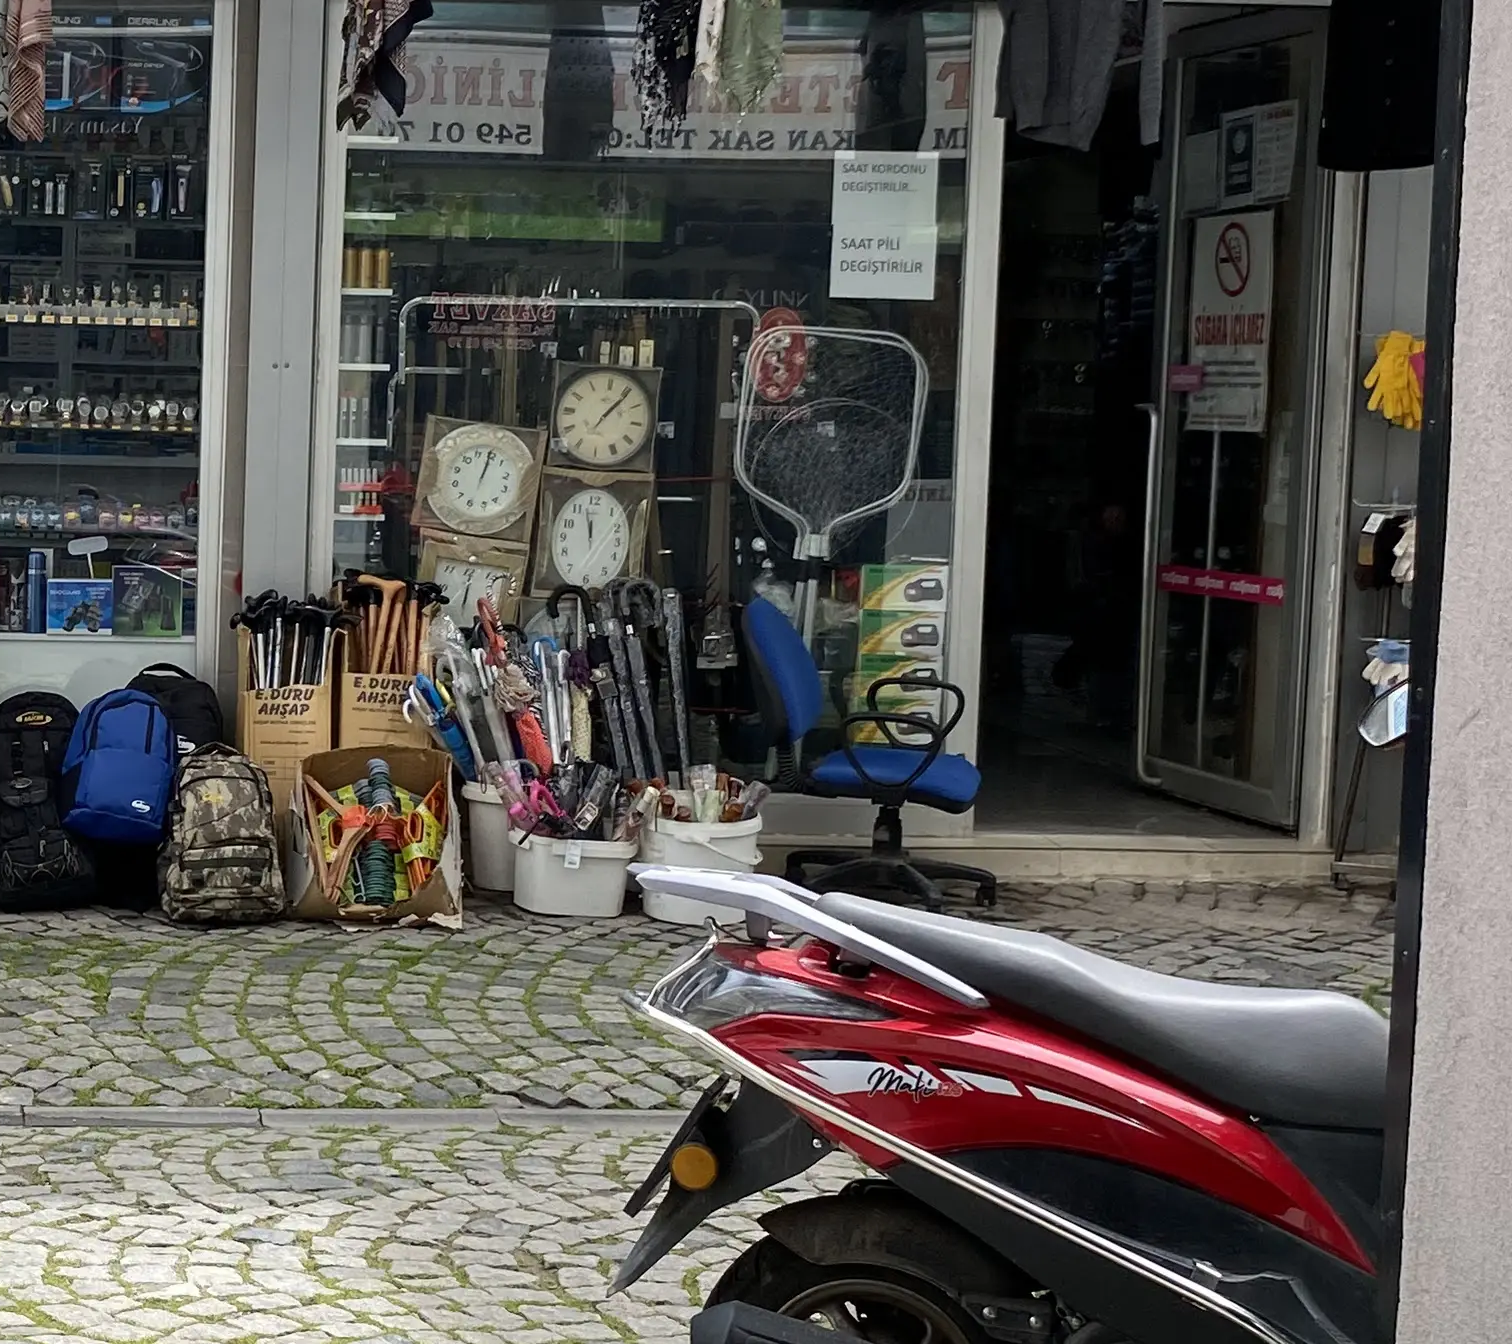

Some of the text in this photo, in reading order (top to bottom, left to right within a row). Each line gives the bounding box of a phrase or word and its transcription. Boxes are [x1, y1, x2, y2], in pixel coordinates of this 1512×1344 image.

[842, 163, 927, 175] SAAT KORDONU
[840, 236, 900, 251] SAAT PİLİ
[589, 496, 601, 506] 12
[572, 504, 582, 514] 11
[563, 519, 574, 529] 10
[255, 688, 315, 702] E.DURU
[258, 702, 310, 719] AHŞAP
